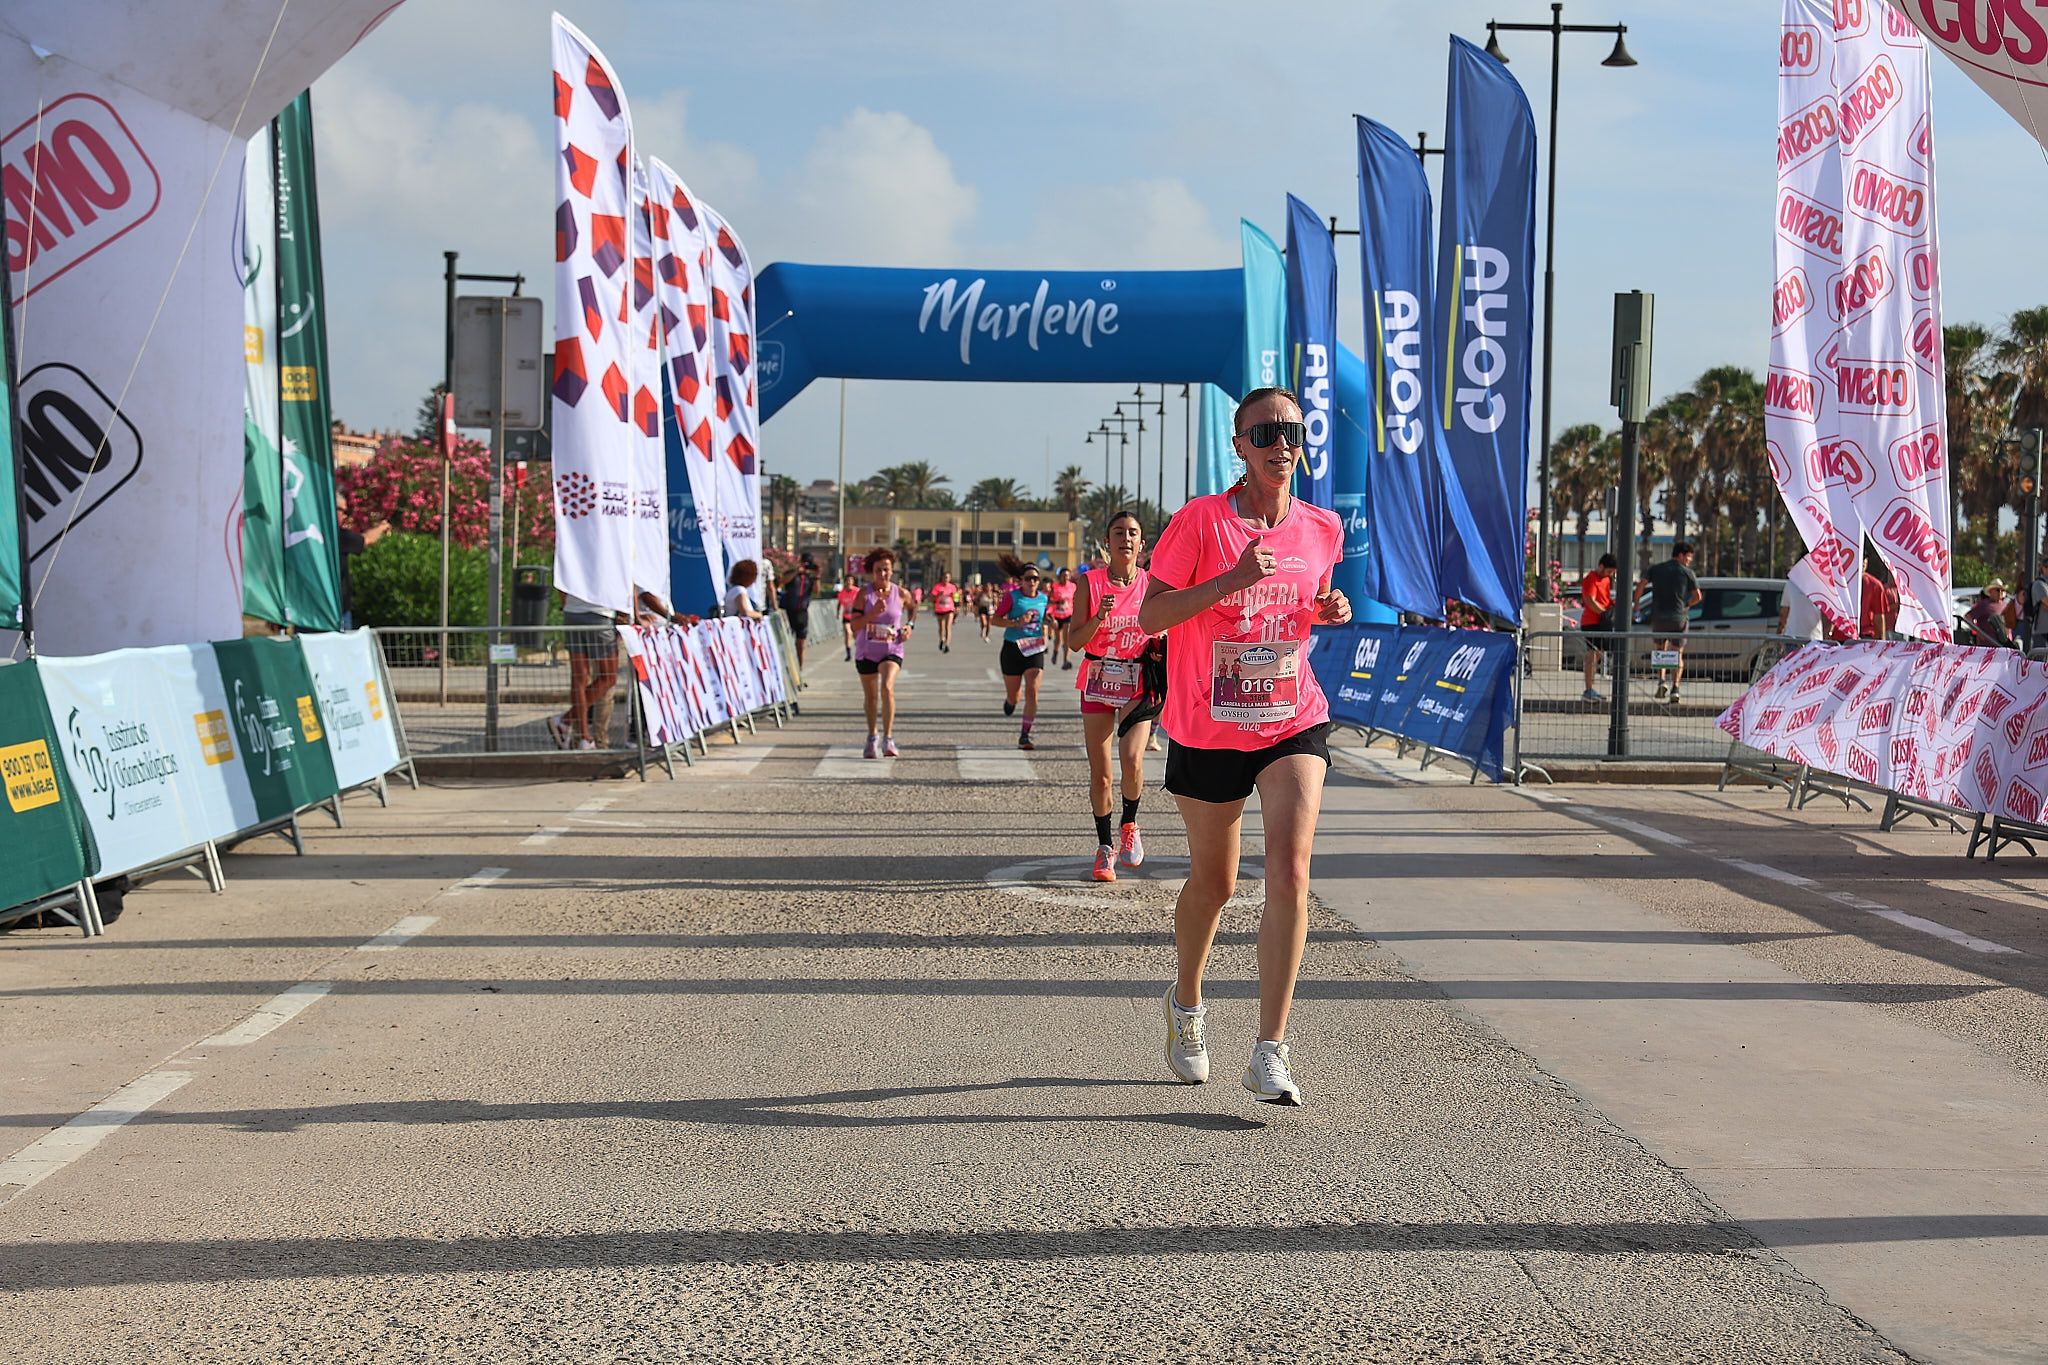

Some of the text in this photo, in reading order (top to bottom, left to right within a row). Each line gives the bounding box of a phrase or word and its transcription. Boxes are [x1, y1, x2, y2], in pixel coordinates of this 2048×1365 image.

[918, 277, 1119, 365] Marlene
[1242, 653, 1275, 662] ASTURIANA
[1102, 681, 1121, 690] 016
[1241, 679, 1275, 693] 016
[1797, 667, 1835, 695] COSMO
[1221, 710, 1290, 718] OYSHO Santander
[1237, 721, 1260, 731] 2026
[1755, 710, 1782, 730] COSMO
[1786, 703, 1821, 733] COSMO
[1861, 702, 1892, 729] COSMO
[1850, 745, 1877, 784] COSMO
[1976, 750, 1998, 805] COSMO
[2006, 781, 2039, 823] COSMO
